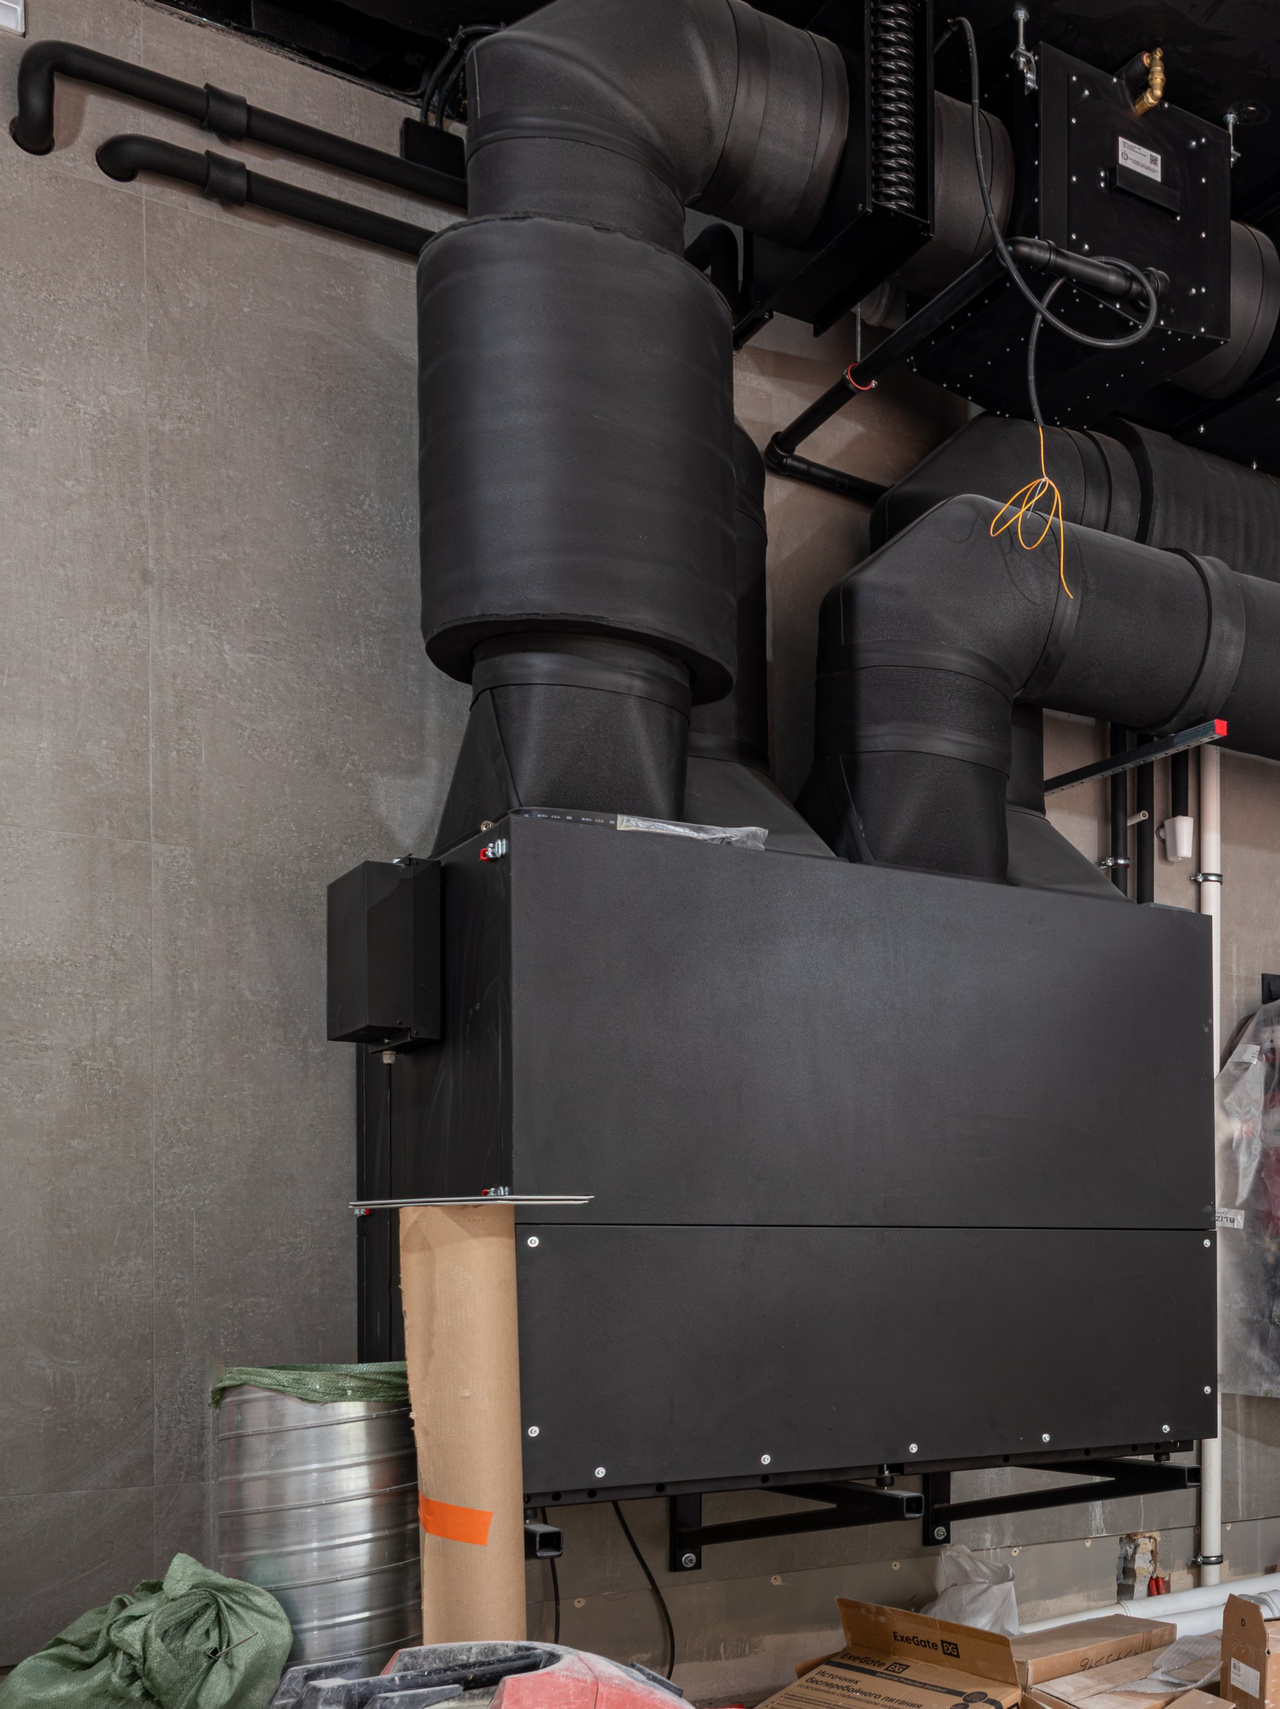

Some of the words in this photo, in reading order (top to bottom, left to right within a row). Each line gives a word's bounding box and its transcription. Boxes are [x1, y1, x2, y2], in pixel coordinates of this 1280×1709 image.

[893, 1631, 939, 1651] ExeGate
[840, 1651, 886, 1668] ExeGate
[815, 1669, 860, 1685] Источник
[805, 1676, 882, 1700] бесперебойного
[882, 1696, 924, 1709] питания
